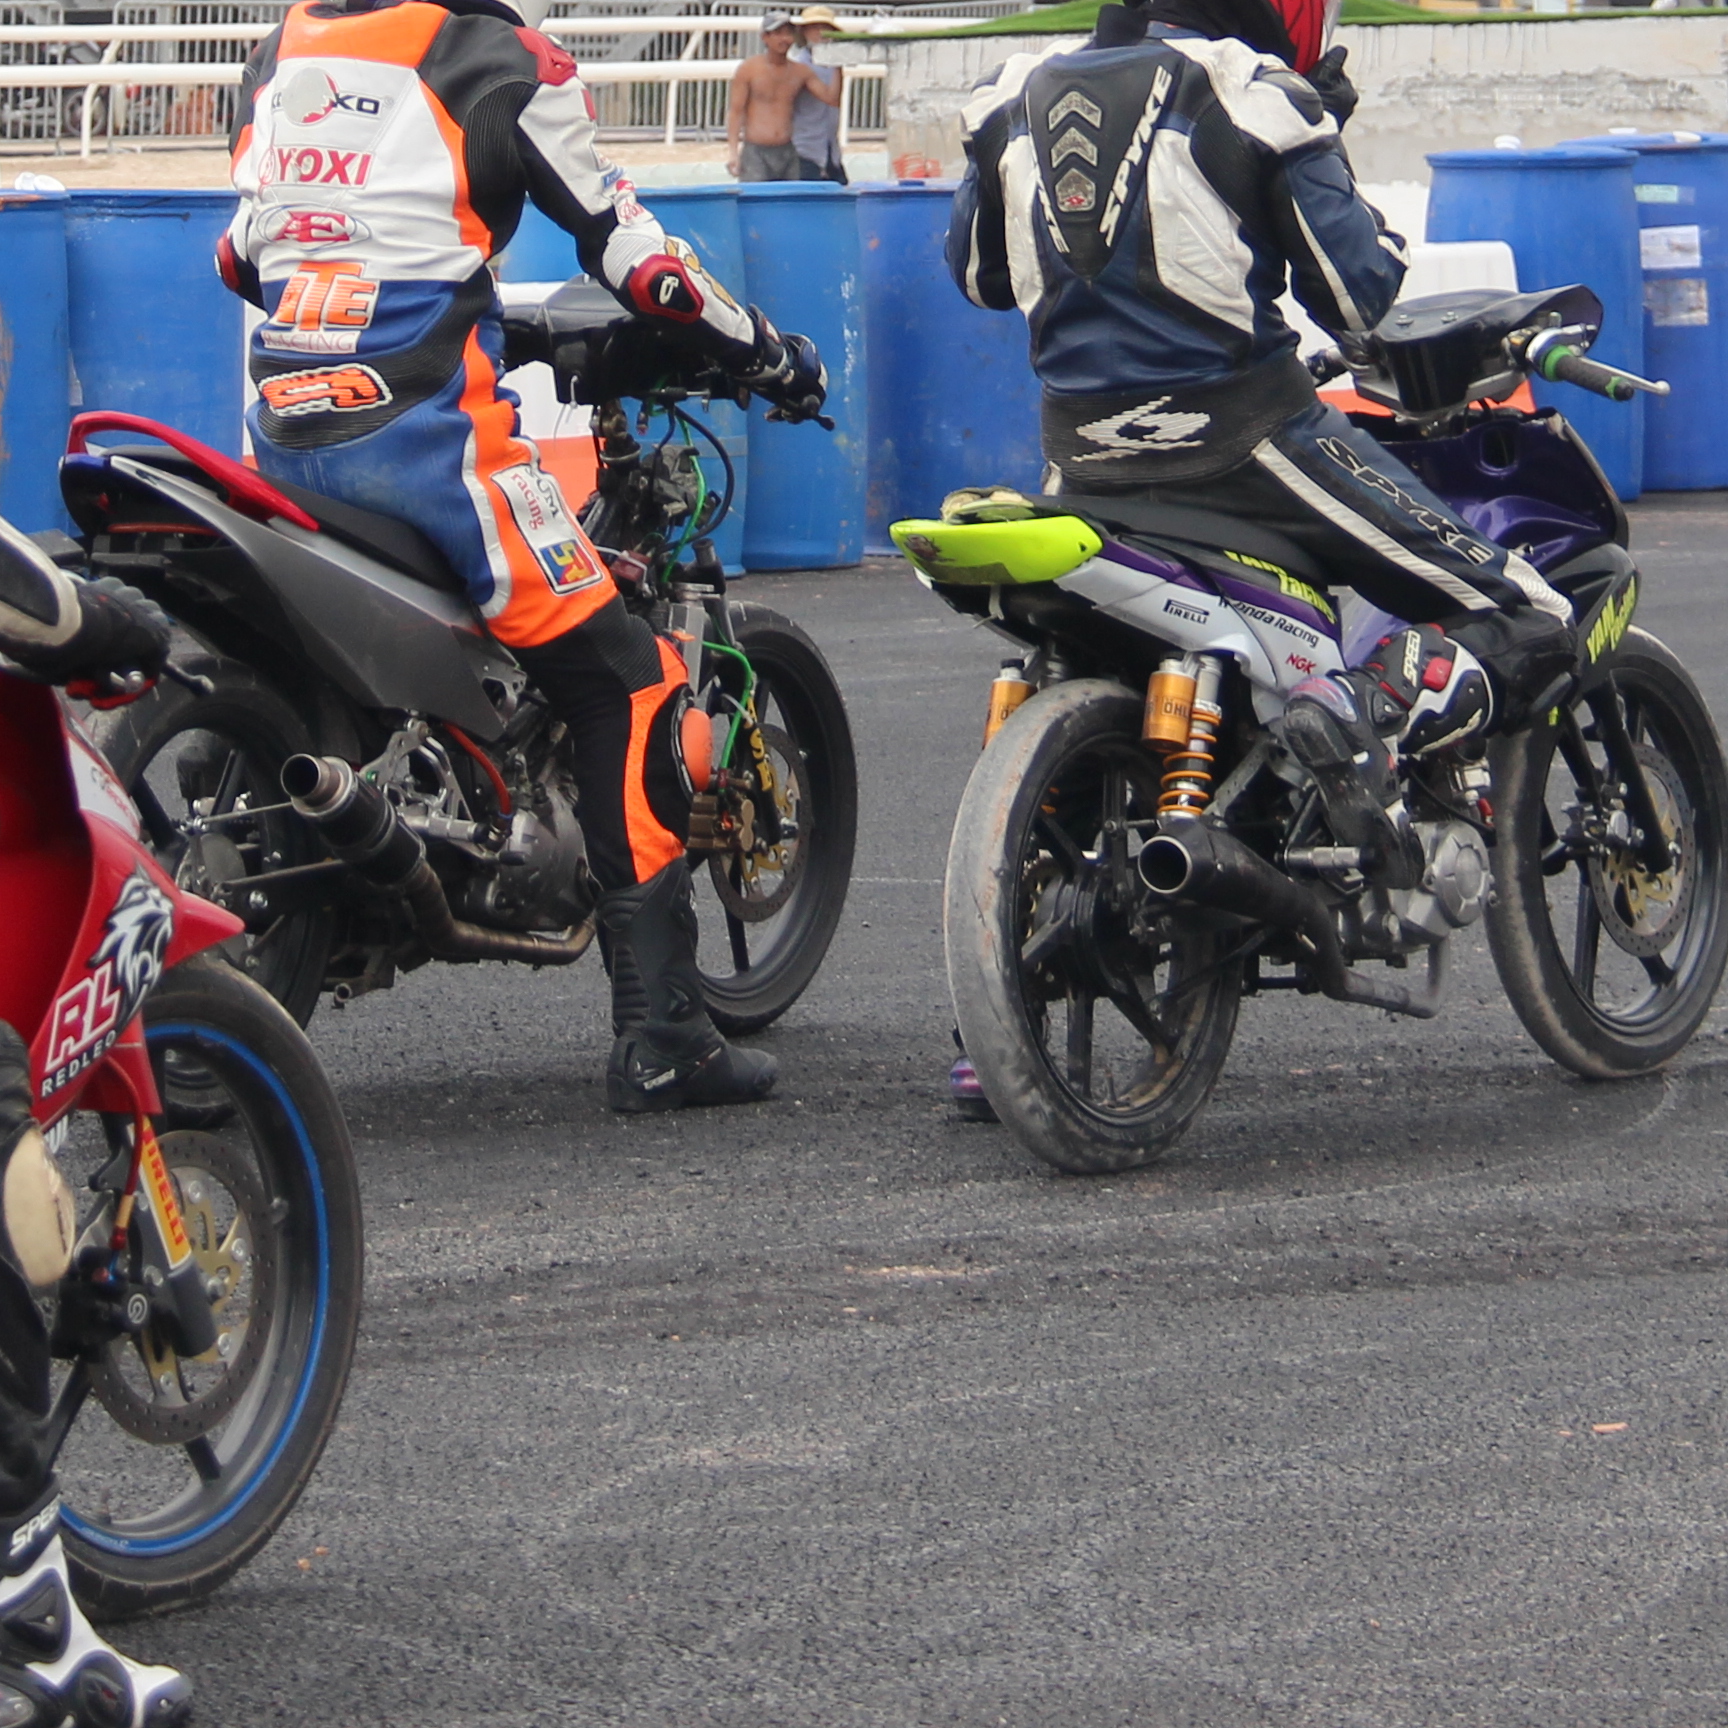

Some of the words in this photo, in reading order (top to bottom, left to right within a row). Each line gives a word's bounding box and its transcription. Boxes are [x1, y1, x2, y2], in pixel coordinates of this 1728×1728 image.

[277, 147, 372, 186] YOXI
[1099, 65, 1173, 248] SPYKE
[510, 472, 546, 531] racing
[1315, 436, 1495, 567] SPYKE
[1162, 598, 1210, 625] PIRELLI
[1274, 616, 1320, 650] Racing
[1285, 652, 1318, 675] NGK
[1402, 629, 1421, 688] SPEED
[44, 960, 122, 1073] RL
[41, 1029, 118, 1099] REDLEO
[8, 1493, 60, 1558] SPE
